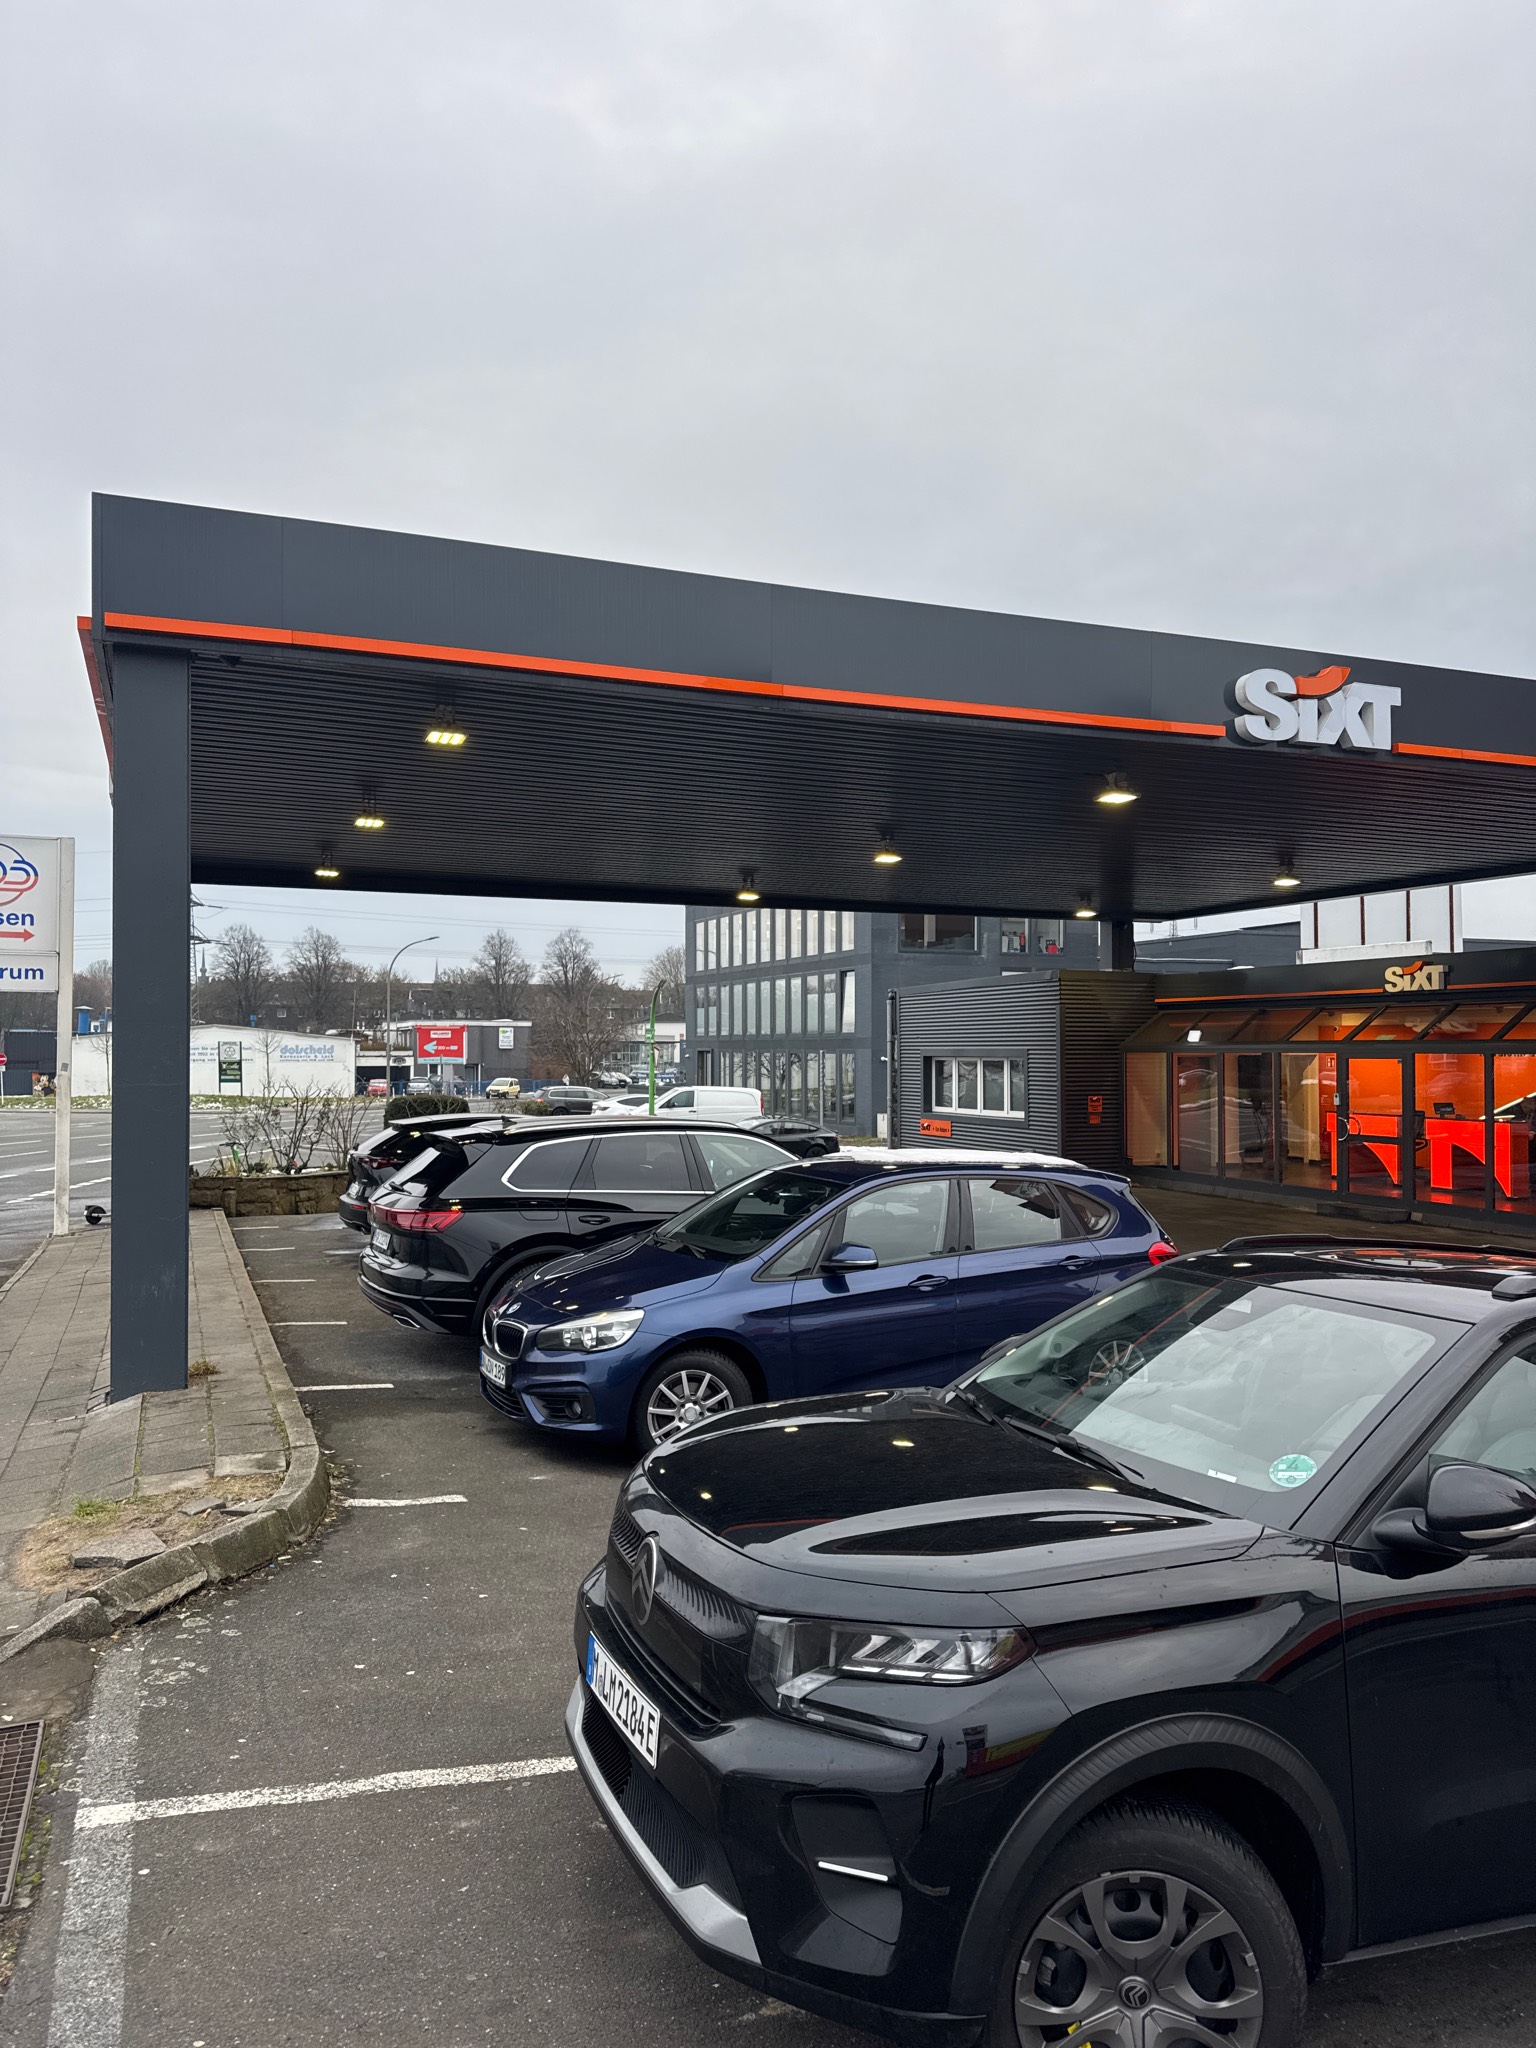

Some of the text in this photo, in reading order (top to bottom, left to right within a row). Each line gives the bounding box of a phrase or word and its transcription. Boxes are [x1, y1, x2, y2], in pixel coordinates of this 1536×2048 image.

[1234, 665, 1401, 750] SIXT
[1384, 961, 1449, 993] SIXT
[1288, 1459, 1300, 1470] 4
